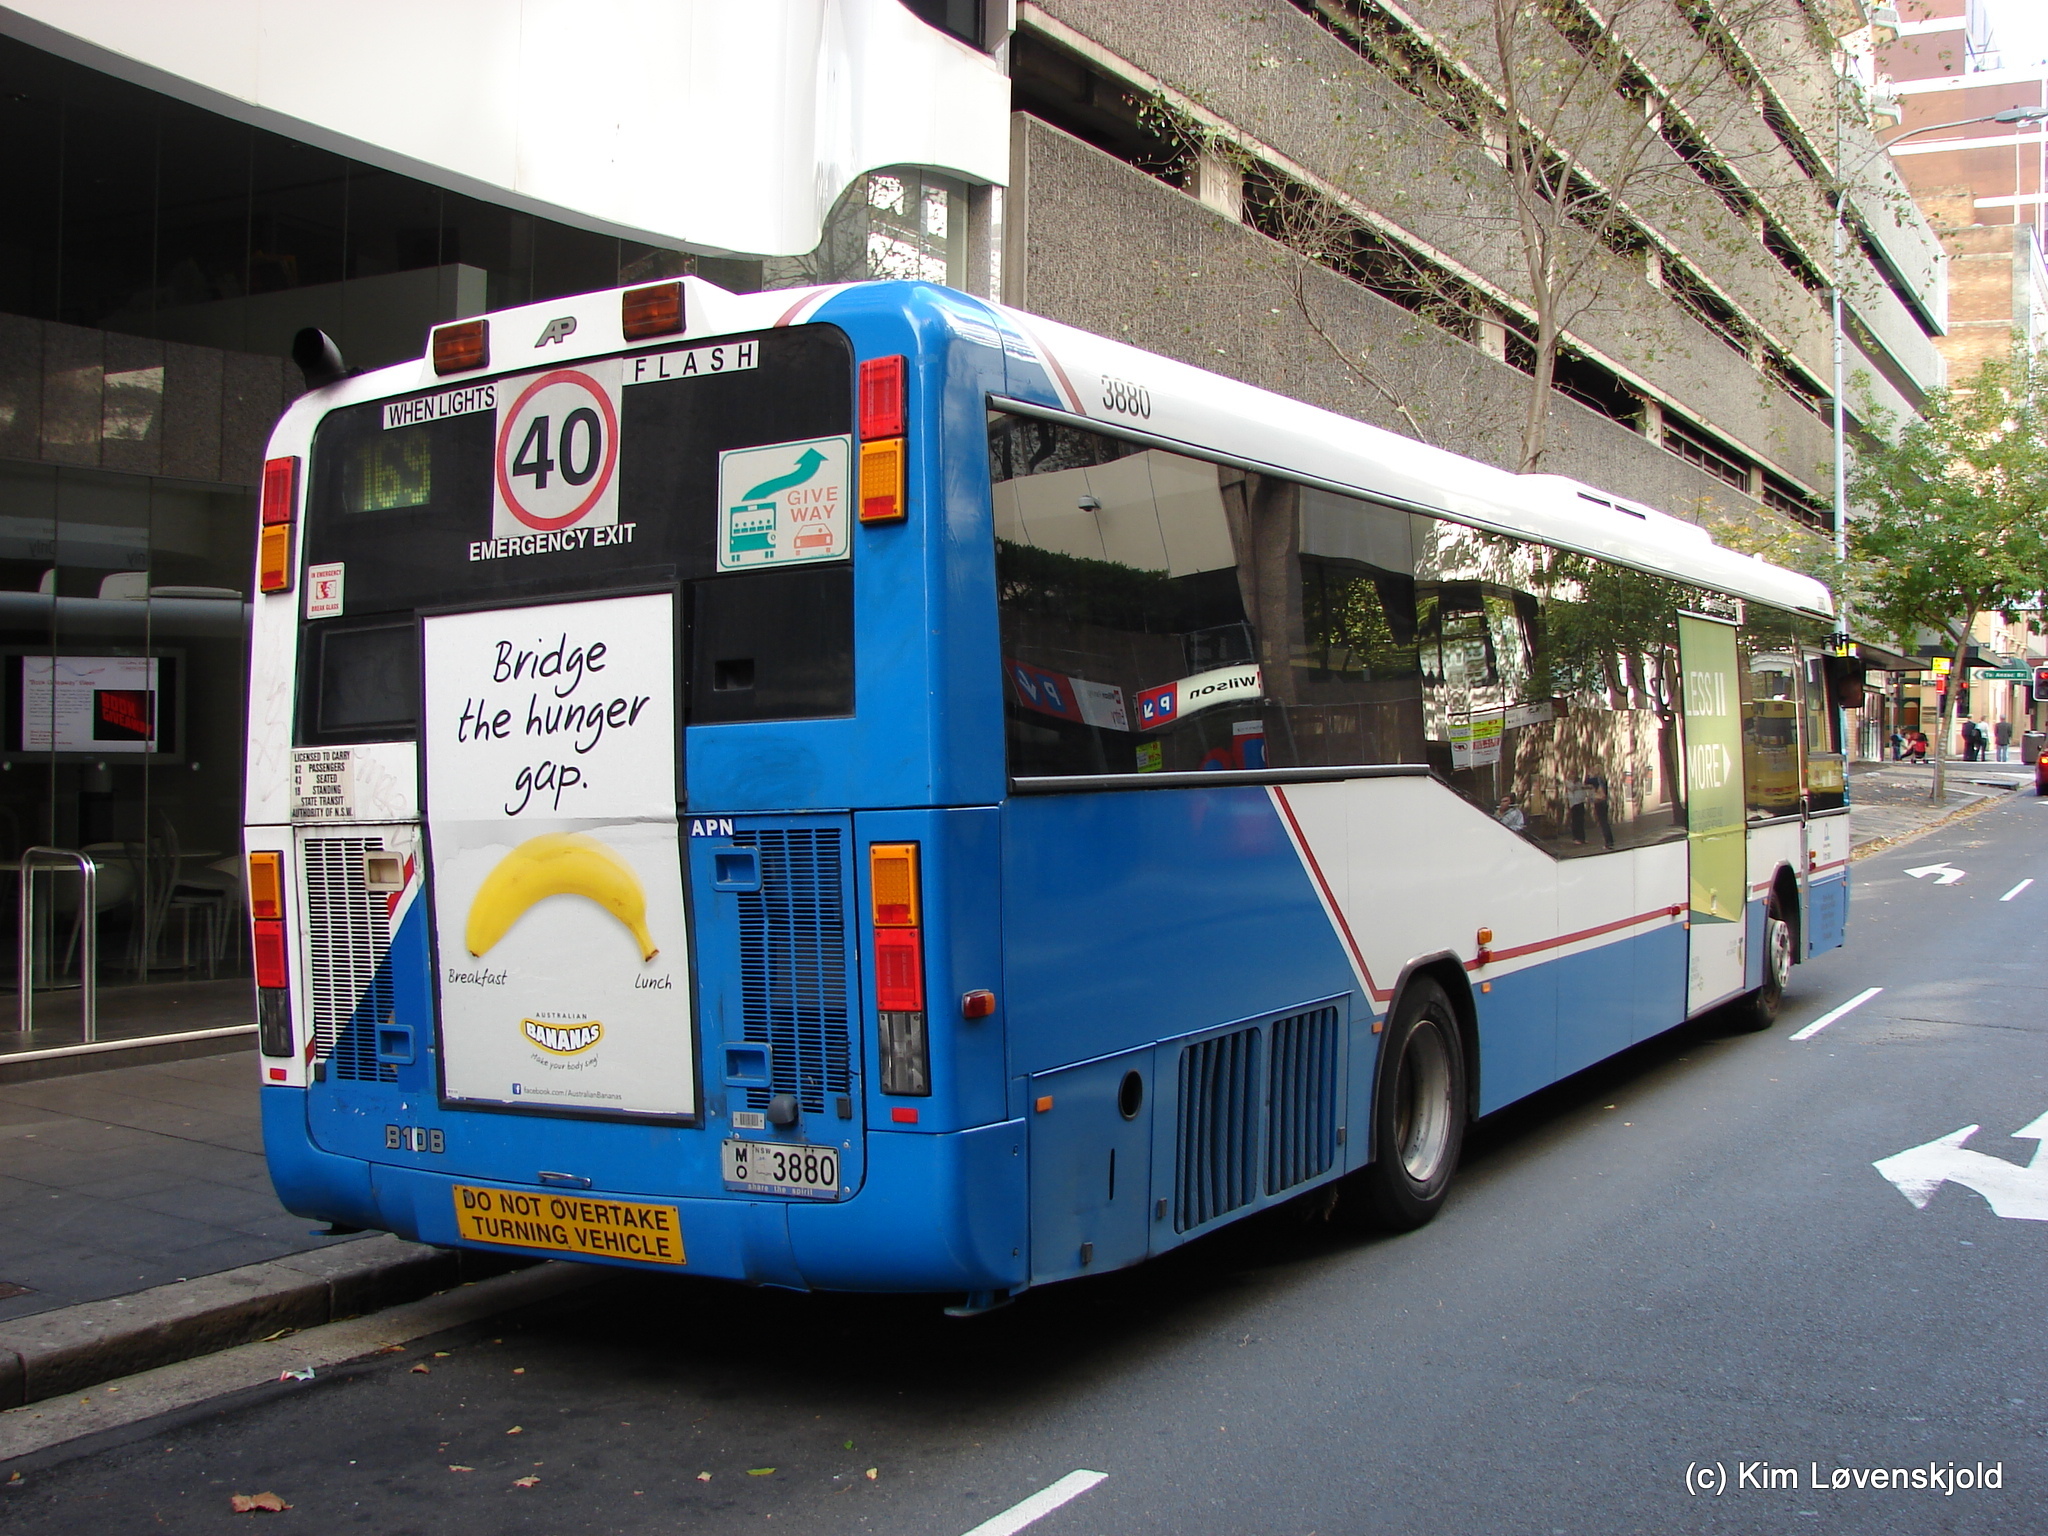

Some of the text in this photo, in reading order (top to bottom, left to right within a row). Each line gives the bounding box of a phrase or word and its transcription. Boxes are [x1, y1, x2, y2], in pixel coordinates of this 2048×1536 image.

[635, 344, 752, 382] FLASH
[389, 385, 495, 427] WHEN LIGHTS
[1101, 374, 1151, 420] 3880
[512, 407, 602, 490] 40
[787, 486, 838, 505] GIVE
[790, 504, 835, 522] WAY
[469, 523, 637, 562] EMERGENCY EXIT
[316, 570, 342, 578] EMERGENCY
[311, 604, 325, 612] BREAK
[493, 632, 607, 698] Bridge
[1685, 671, 1713, 716] LESS
[458, 693, 651, 754] the hunger
[294, 750, 350, 762] LICENSED TO CARRY
[308, 762, 345, 773] PASSENGERS
[1687, 743, 1721, 791] MORE
[316, 774, 337, 784] SEATED
[504, 760, 588, 816] gap.
[312, 785, 341, 795] STANDING
[301, 796, 344, 806] STATE TRANSIT
[292, 807, 353, 818] AUTHORITY OF N.S.W.
[691, 818, 734, 837] APN
[448, 968, 508, 987] Breakfast
[634, 973, 672, 990] Lunch
[525, 1020, 600, 1051] BANANAS
[531, 1053, 548, 1067] Make
[549, 1062, 565, 1070] your
[567, 1061, 583, 1071] body
[773, 1152, 835, 1186] 3880
[748, 1184, 813, 1196] share the spirit
[463, 1189, 670, 1231] DO NOT OVERTAKE
[472, 1216, 672, 1258] TURNING VEHICLE
